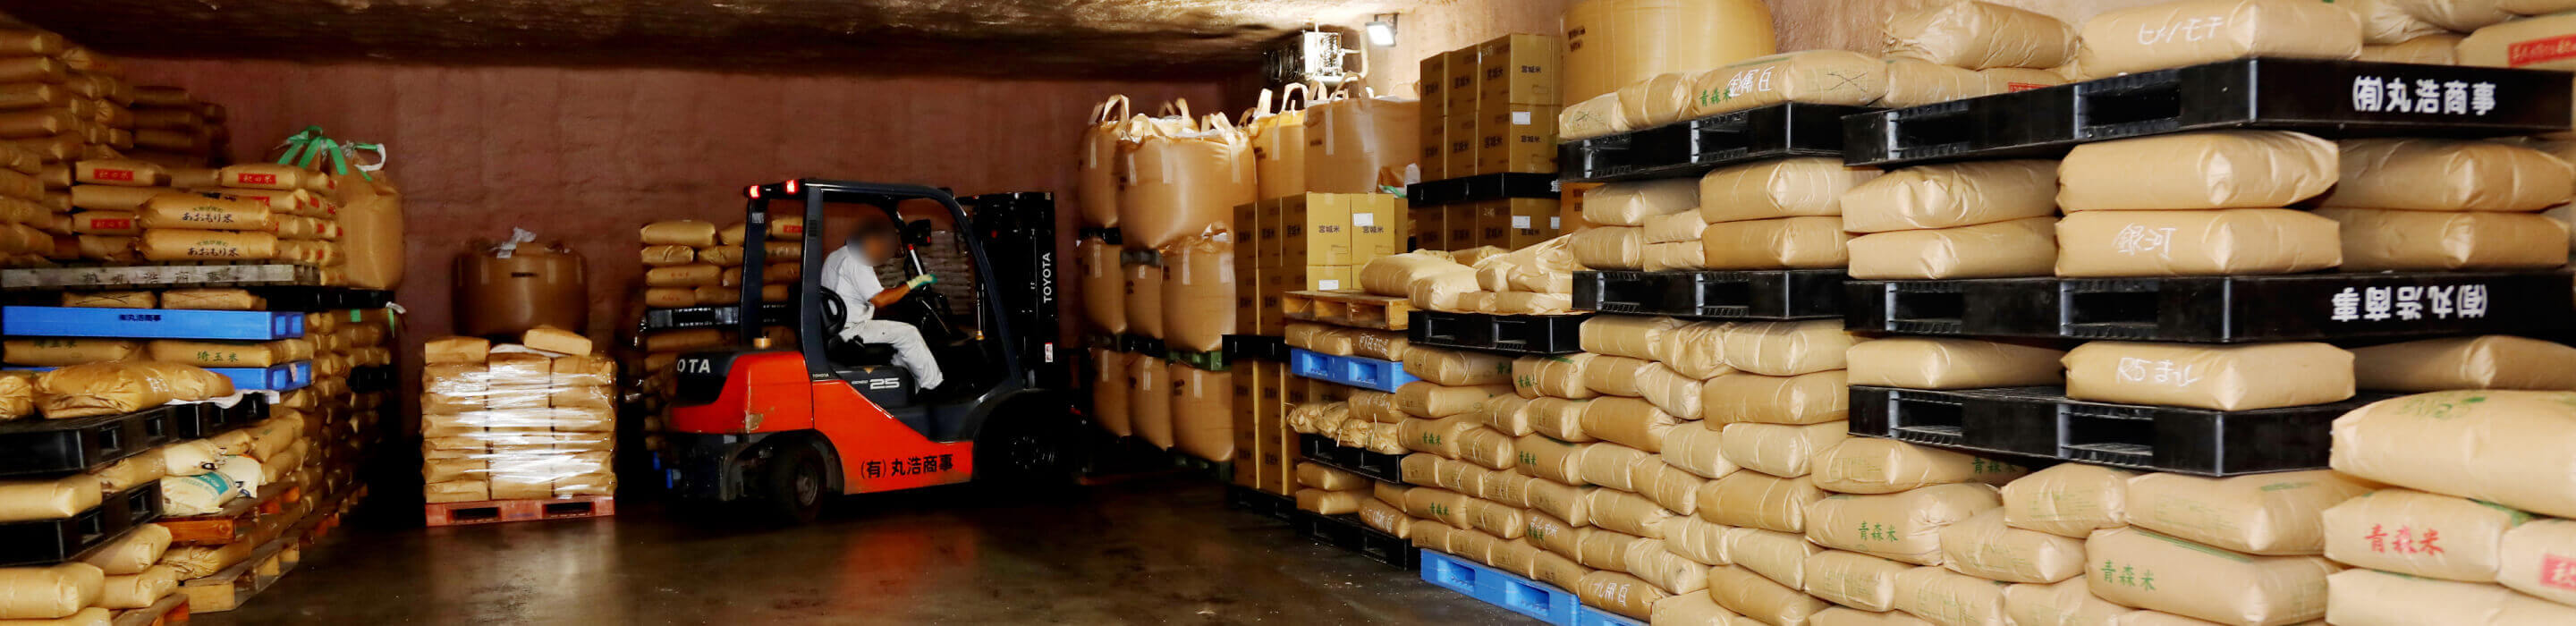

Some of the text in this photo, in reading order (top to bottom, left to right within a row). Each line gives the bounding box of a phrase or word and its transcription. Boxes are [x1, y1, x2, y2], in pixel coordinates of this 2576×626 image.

[1521, 65, 1541, 73] 宮城米
[2352, 75, 2496, 115] (有)丸浩商事
[1318, 225, 1340, 233] 宮城米
[1362, 225, 1384, 234] 宮城米
[1042, 252, 1052, 303] TOYOTA
[869, 377, 900, 390] 25
[860, 453, 953, 478] (有)丸浩商事
[1858, 520, 1898, 543] 青森米
[2365, 524, 2445, 556] 青森米
[2100, 560, 2157, 592] 青森米
